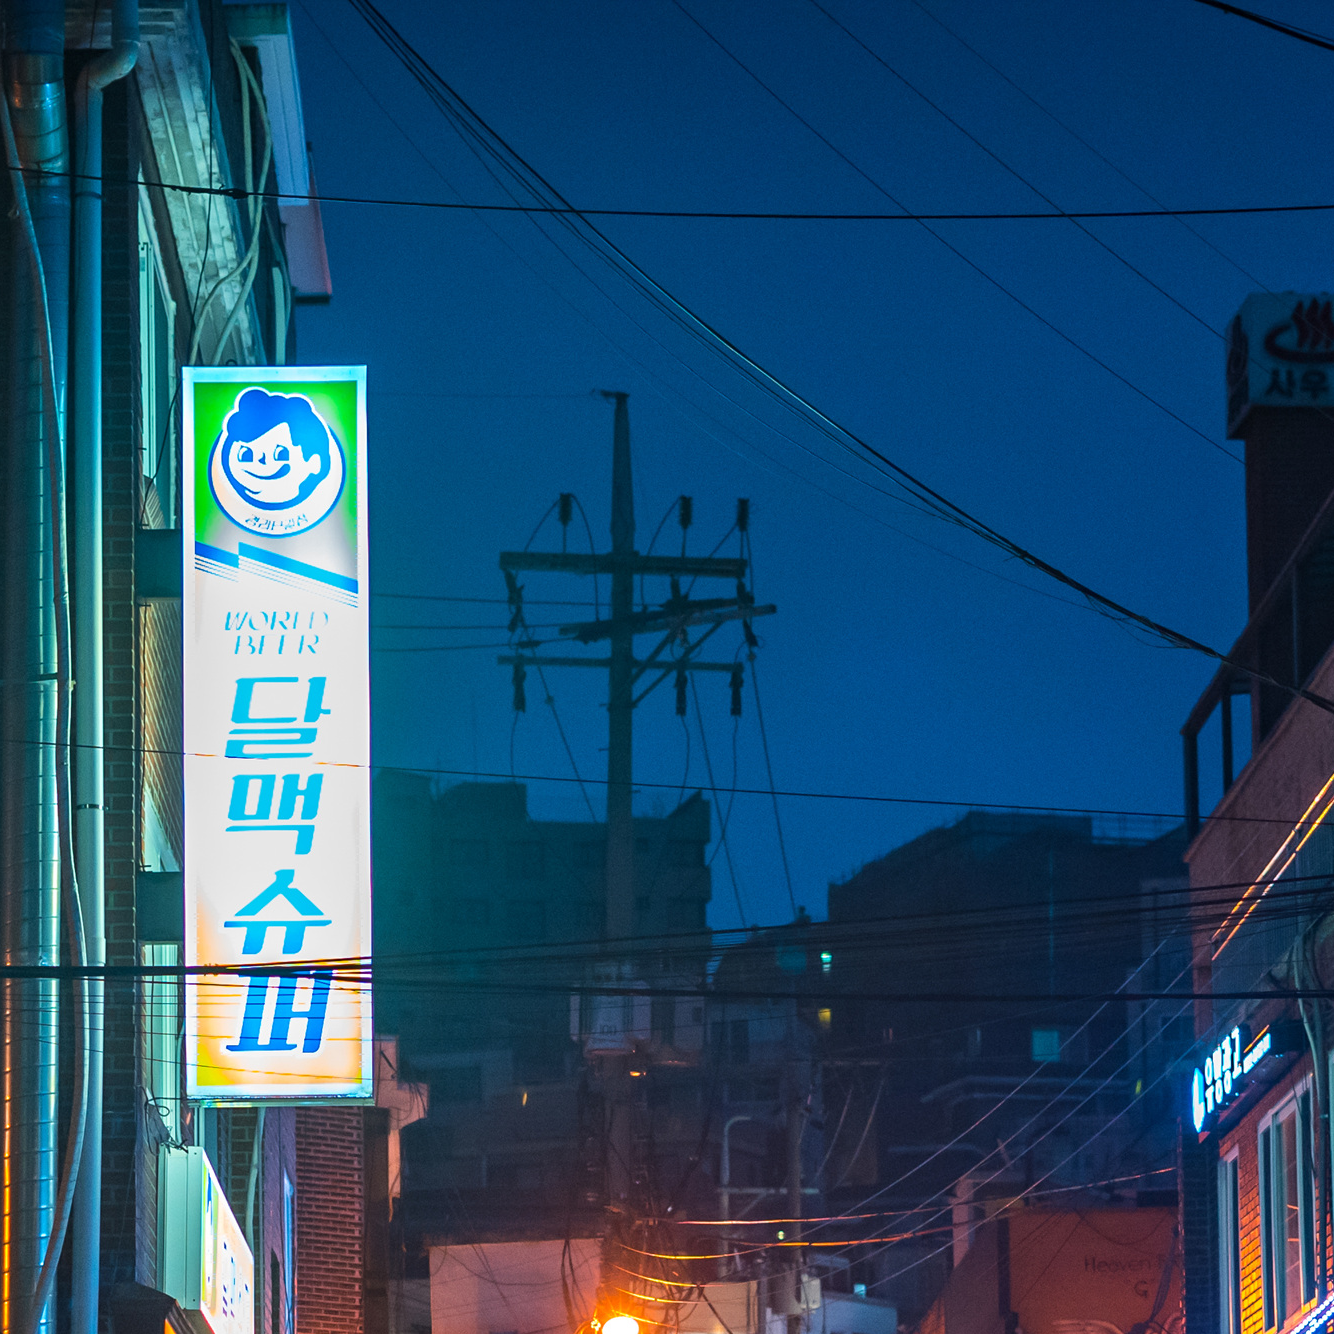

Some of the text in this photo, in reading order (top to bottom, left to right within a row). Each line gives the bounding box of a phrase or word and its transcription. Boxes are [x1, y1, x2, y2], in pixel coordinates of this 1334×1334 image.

[224, 610, 329, 632] WORLD
[233, 633, 320, 656] BEER
[224, 676, 333, 1054] 달맥슈퍼
